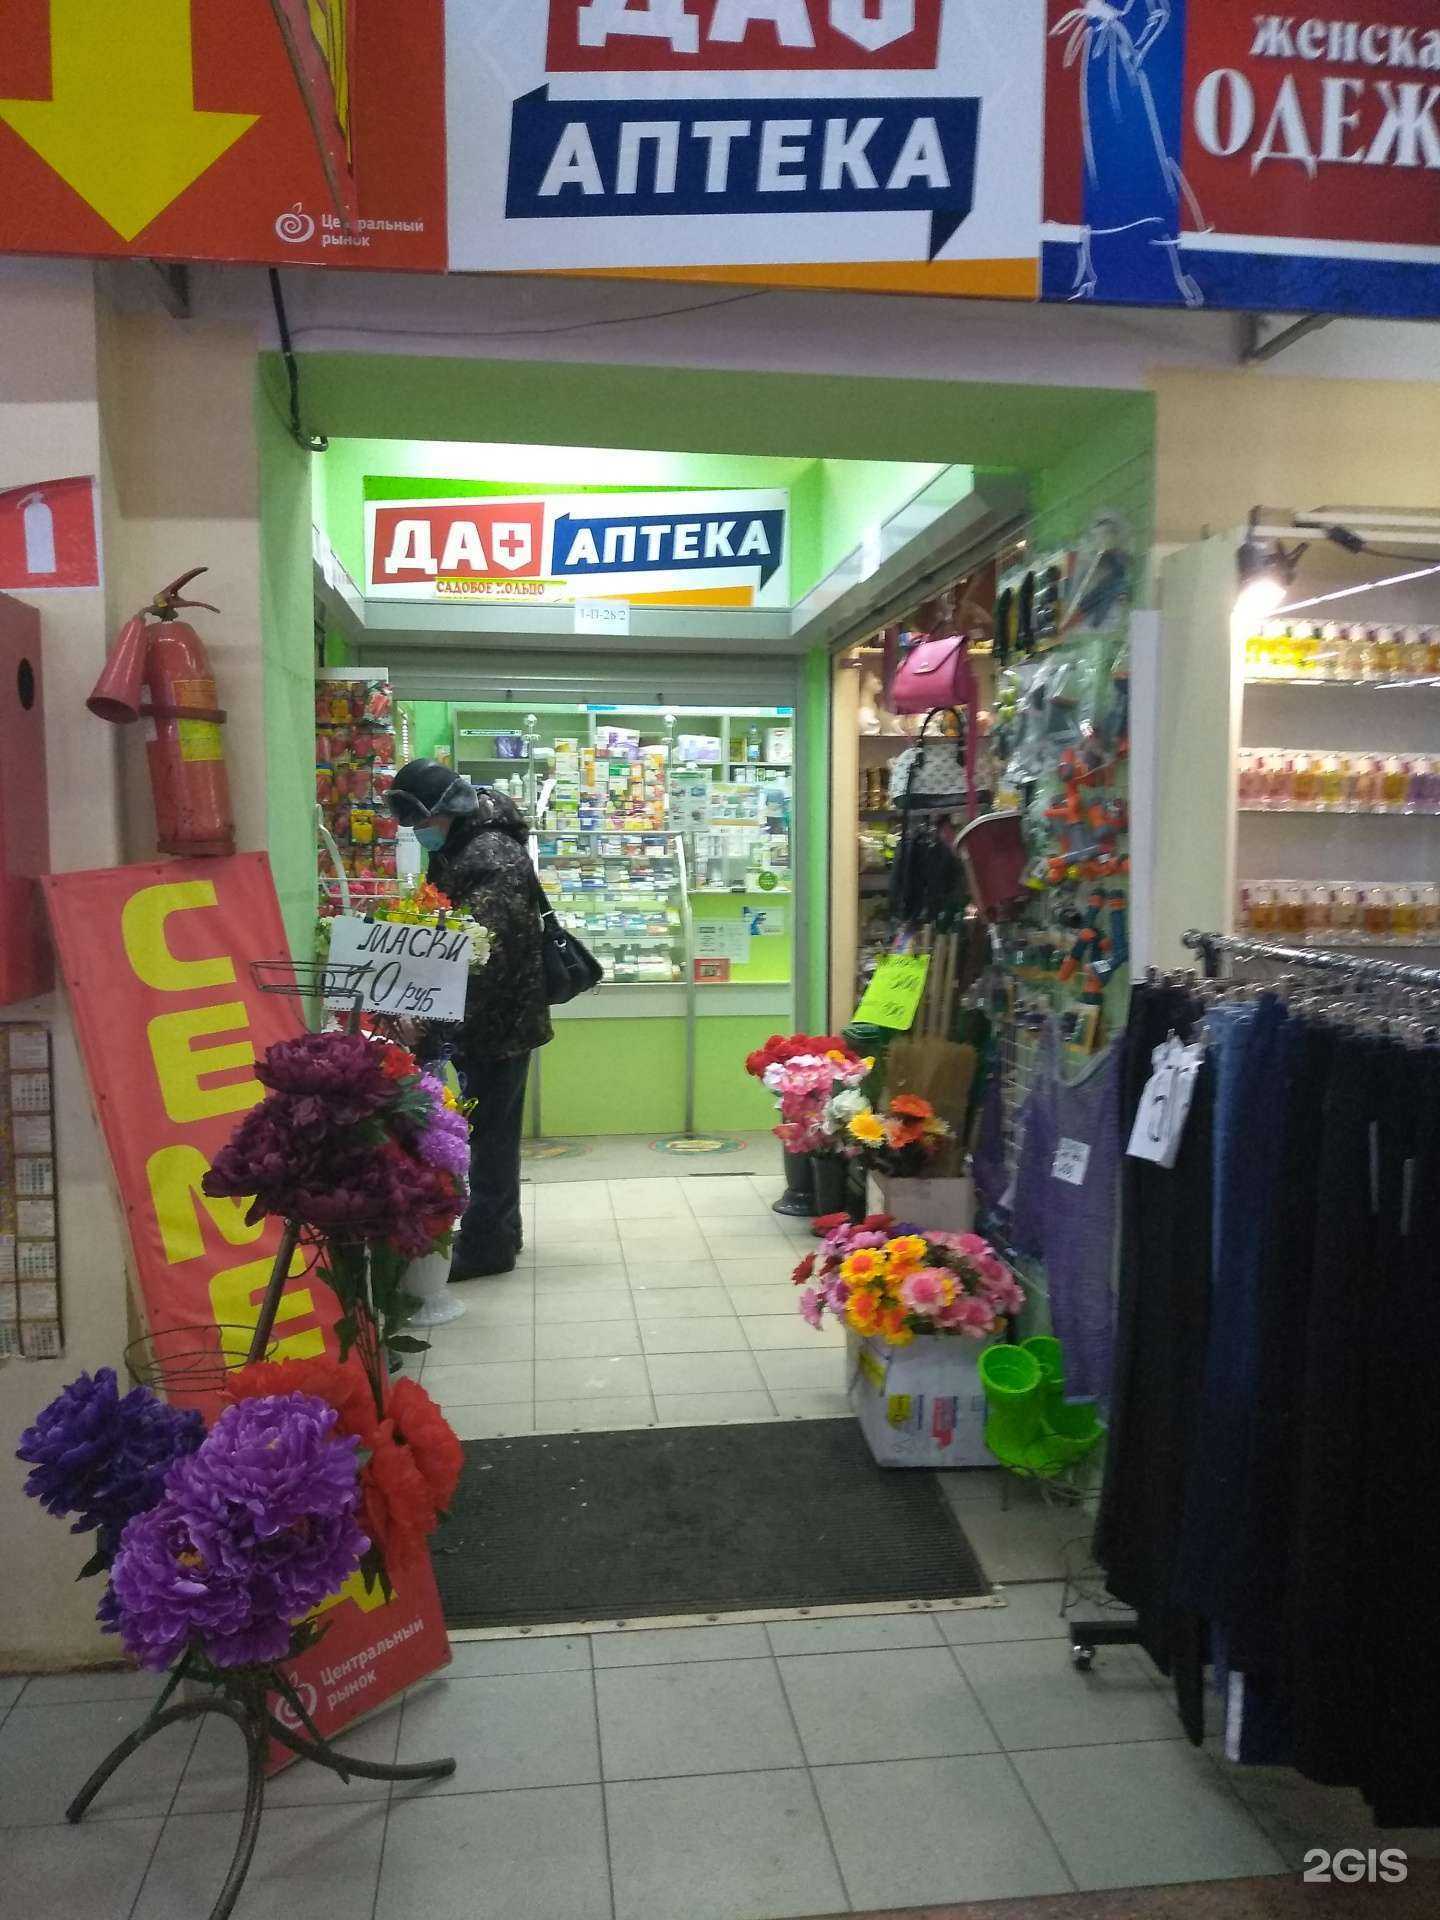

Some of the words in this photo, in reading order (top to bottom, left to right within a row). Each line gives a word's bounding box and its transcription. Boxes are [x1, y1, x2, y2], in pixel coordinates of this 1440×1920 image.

[537, 116, 951, 196] АПТЕКА
[321, 213, 424, 232] Церальный
[564, 519, 772, 566] АПТЕКА
[356, 924, 469, 963] МАСКИ
[319, 1614, 425, 1687] Центральный
[326, 1669, 377, 1712] рынок
